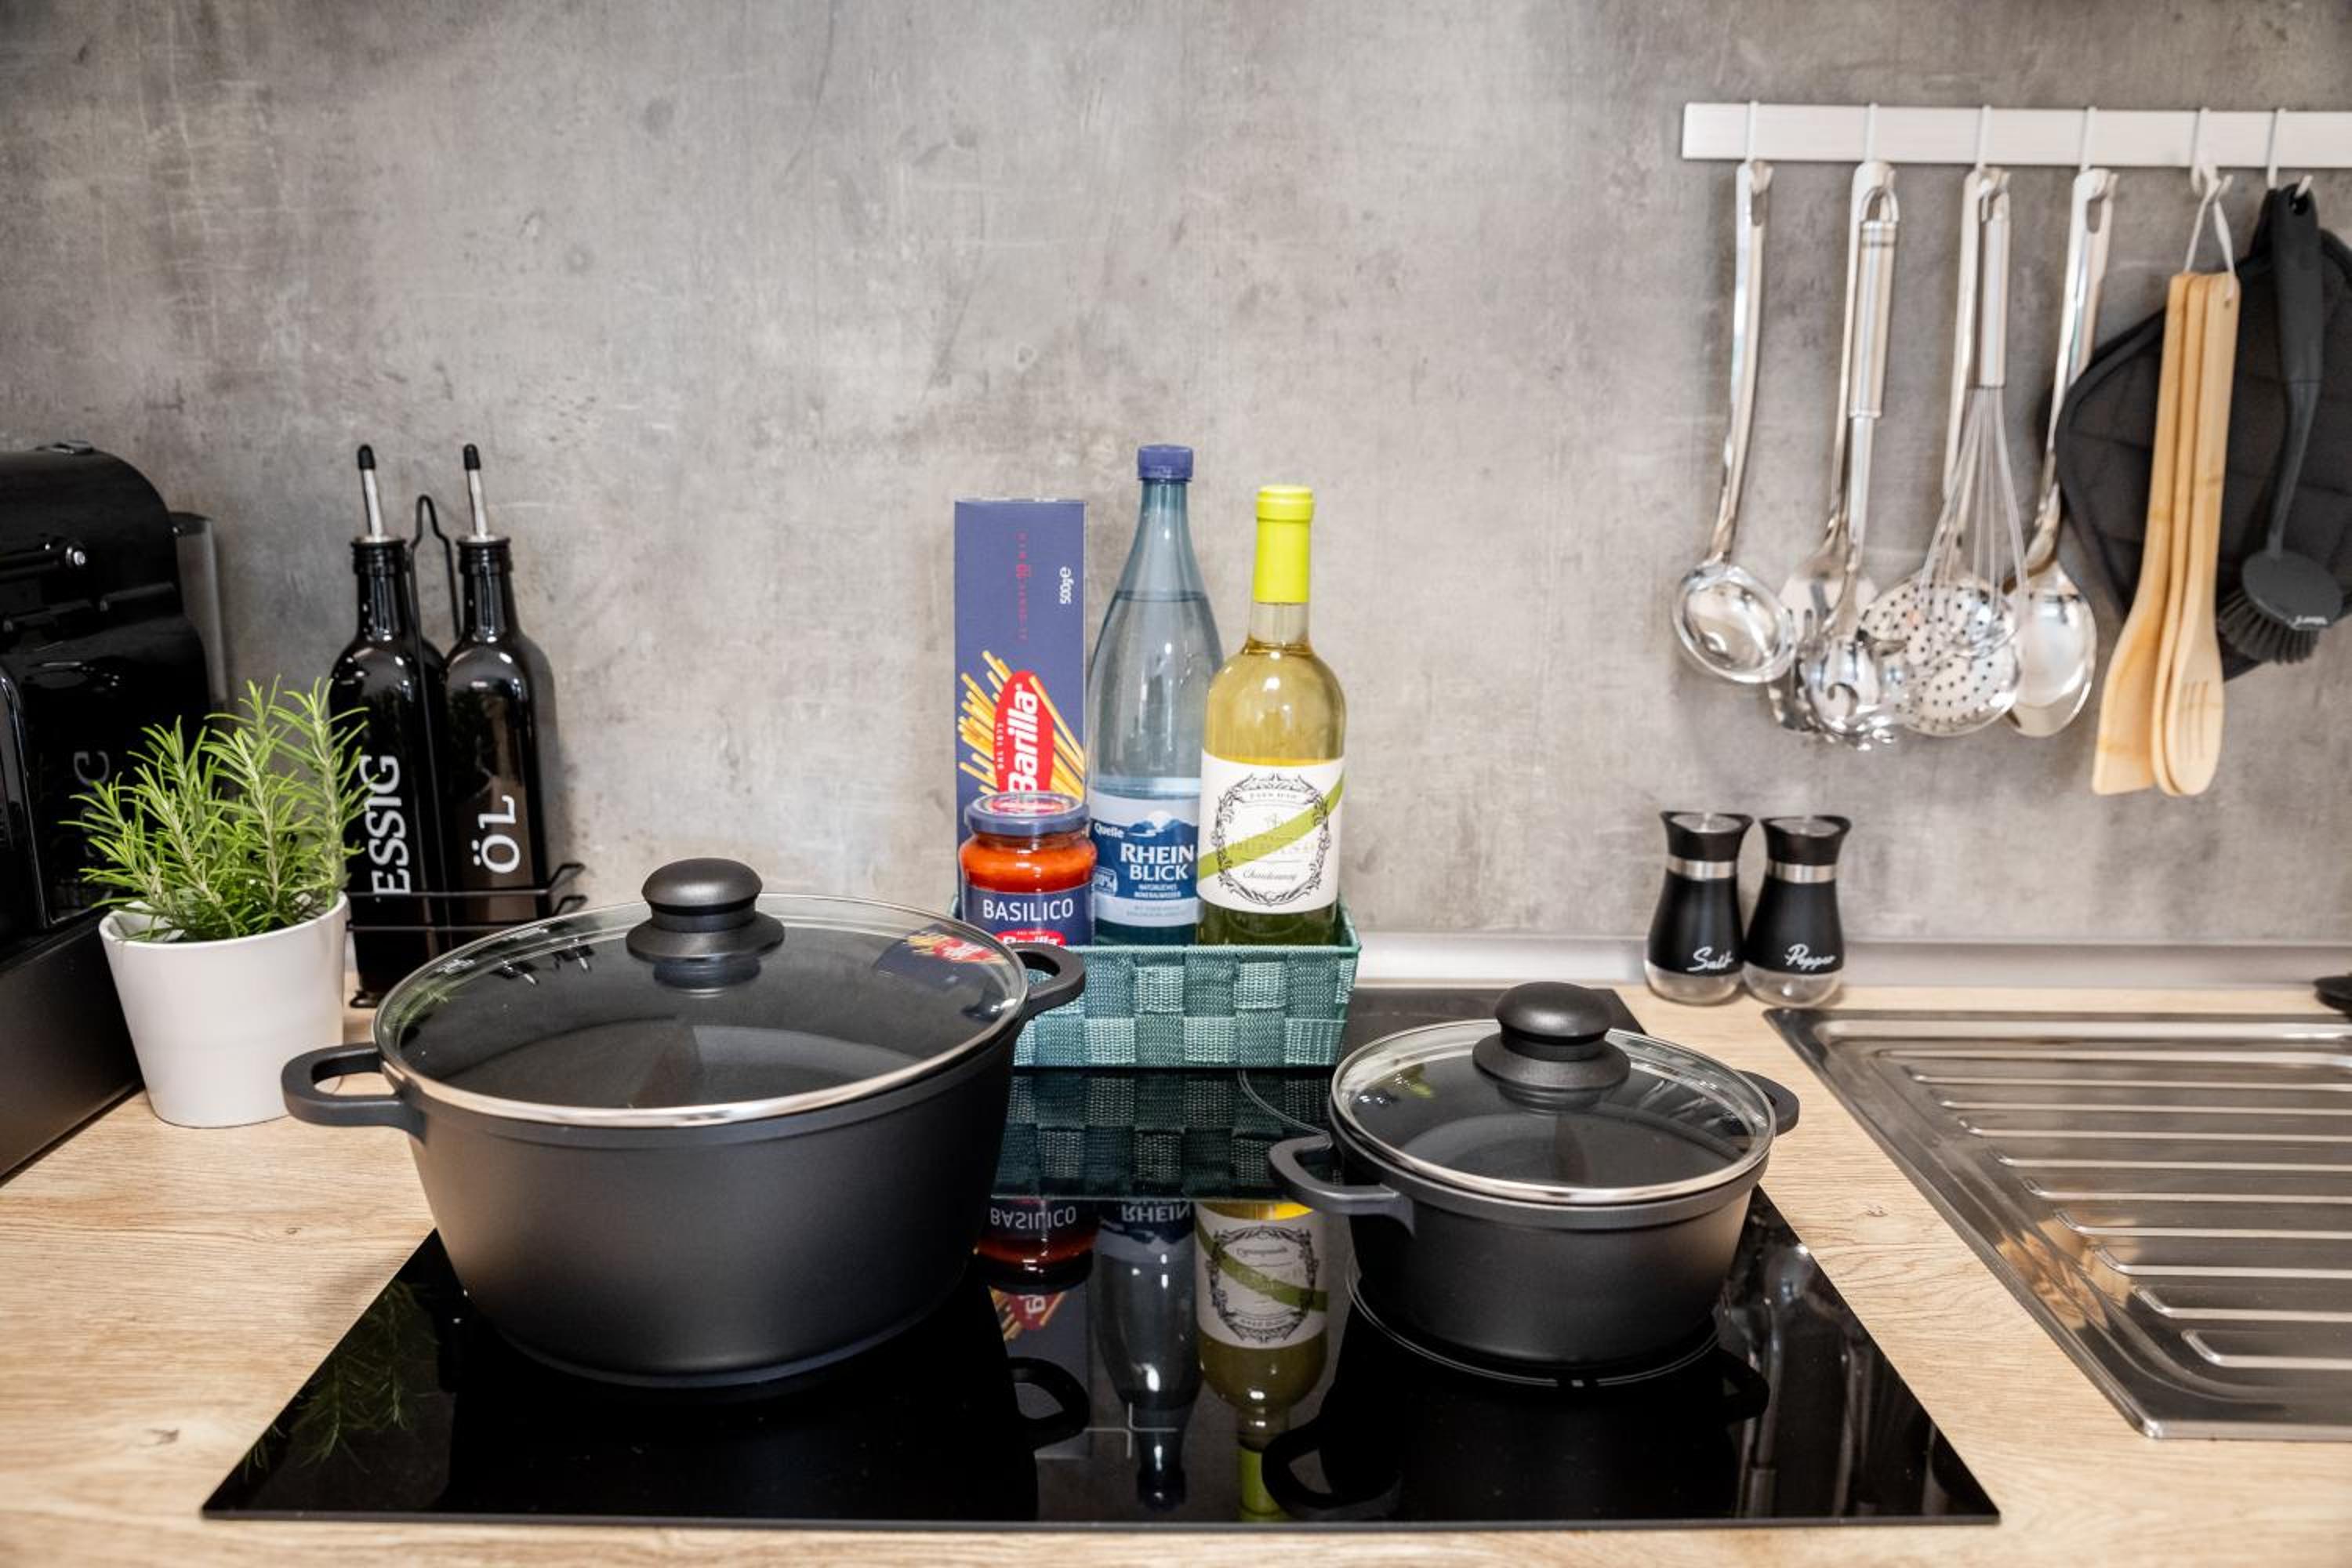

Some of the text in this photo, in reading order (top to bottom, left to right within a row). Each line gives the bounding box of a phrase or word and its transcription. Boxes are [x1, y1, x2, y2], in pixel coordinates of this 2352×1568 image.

[1007, 689, 1039, 793] Barilla
[358, 754, 412, 899] ESSIG
[470, 794, 521, 874] ÖL
[1094, 822, 1125, 839] Quelle
[1119, 842, 1195, 865] RHEIN
[1129, 864, 1189, 881] BLICK
[982, 898, 1074, 921] BASILICO
[1686, 946, 1734, 971] Salt
[1784, 943, 1836, 971] Pepper
